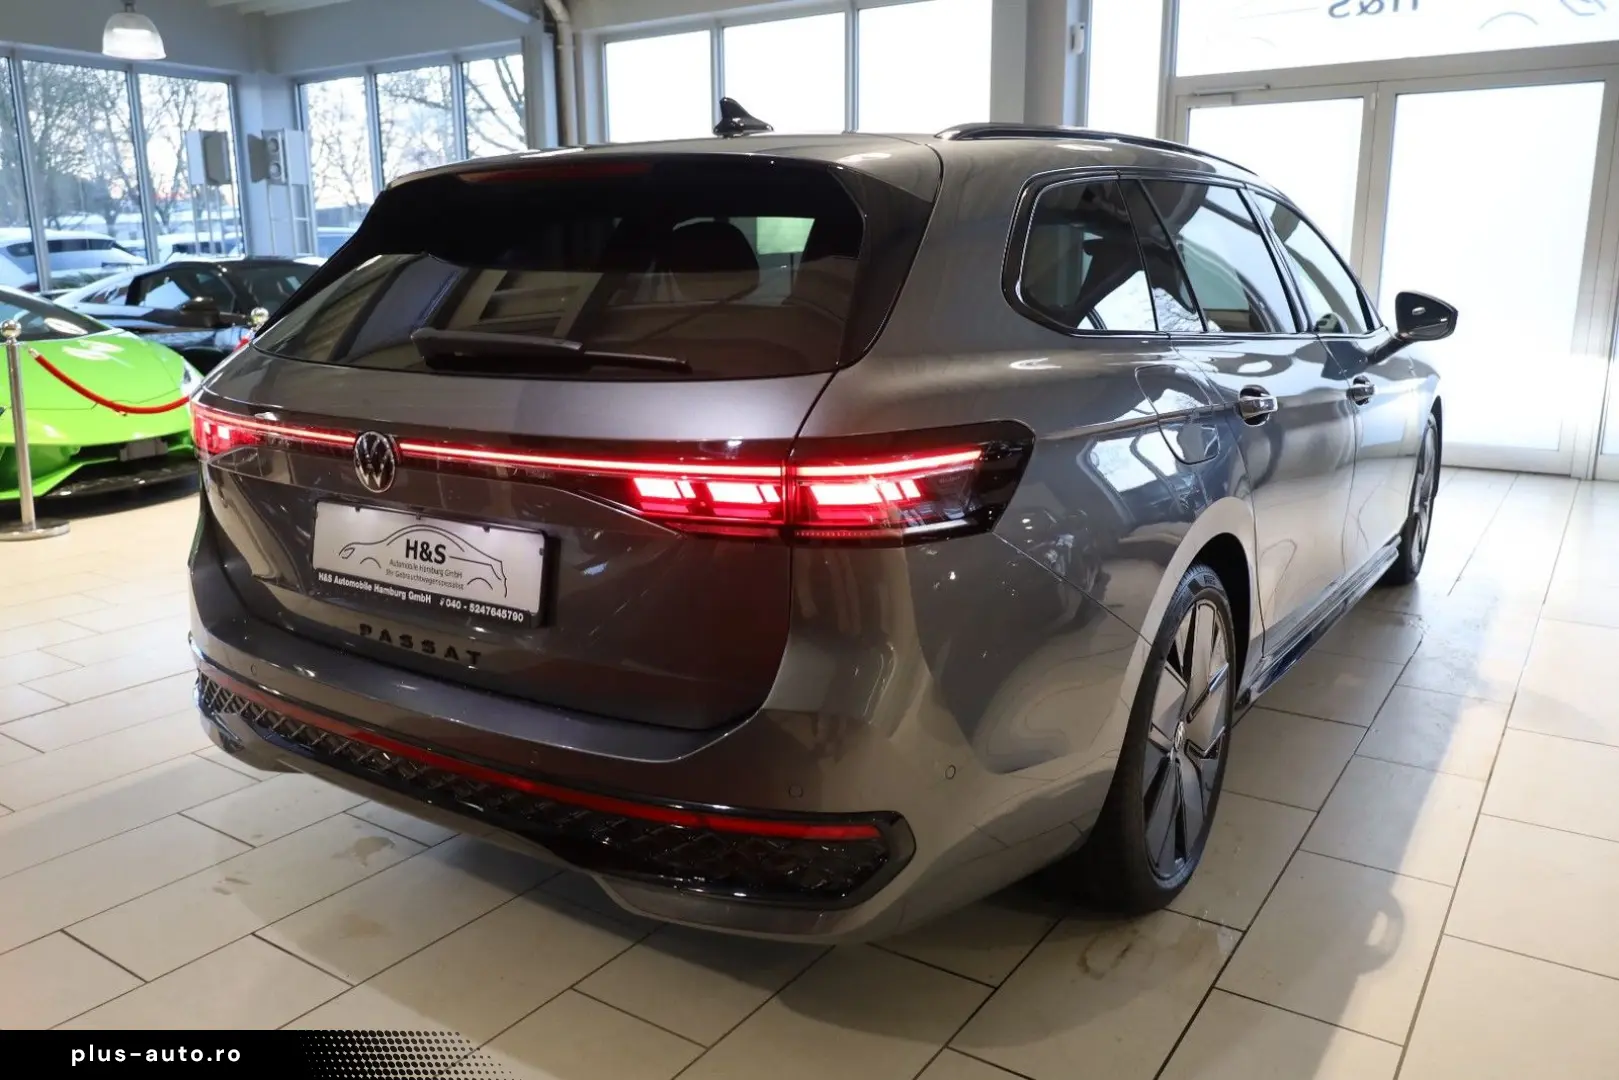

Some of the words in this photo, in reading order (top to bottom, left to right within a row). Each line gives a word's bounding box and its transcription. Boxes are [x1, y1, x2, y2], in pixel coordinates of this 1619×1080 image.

[405, 538, 447, 565] H&S
[318, 572, 333, 583] H&S
[333, 575, 373, 592] Automobile
[373, 583, 407, 600] Hamburg
[408, 591, 432, 605] GmbH
[359, 623, 482, 666] PASSAT
